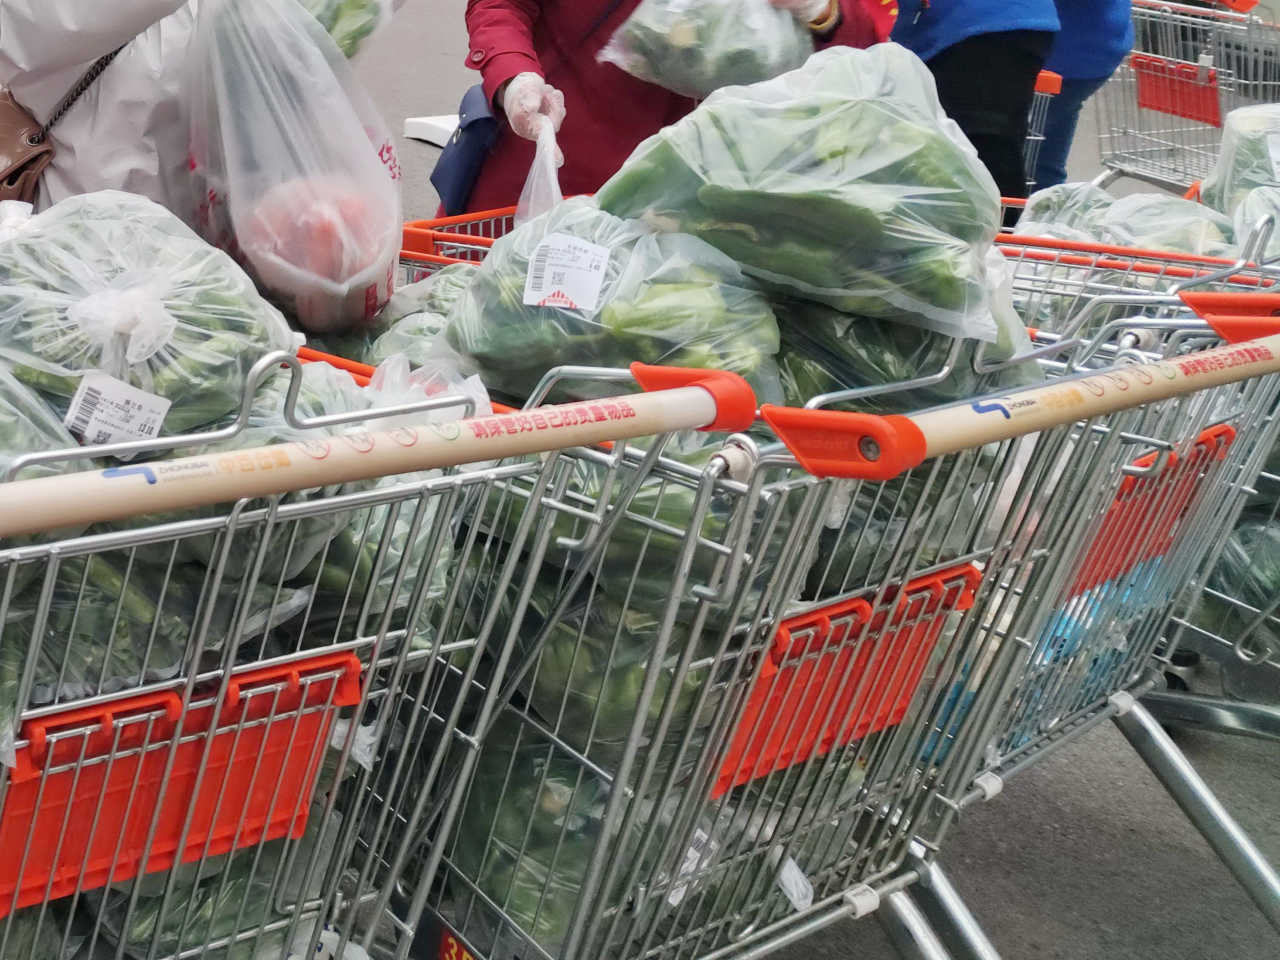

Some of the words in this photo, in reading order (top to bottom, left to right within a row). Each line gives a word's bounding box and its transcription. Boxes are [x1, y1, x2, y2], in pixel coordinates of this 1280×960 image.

[469, 402, 637, 439] 请保管好自己的贵重物品
